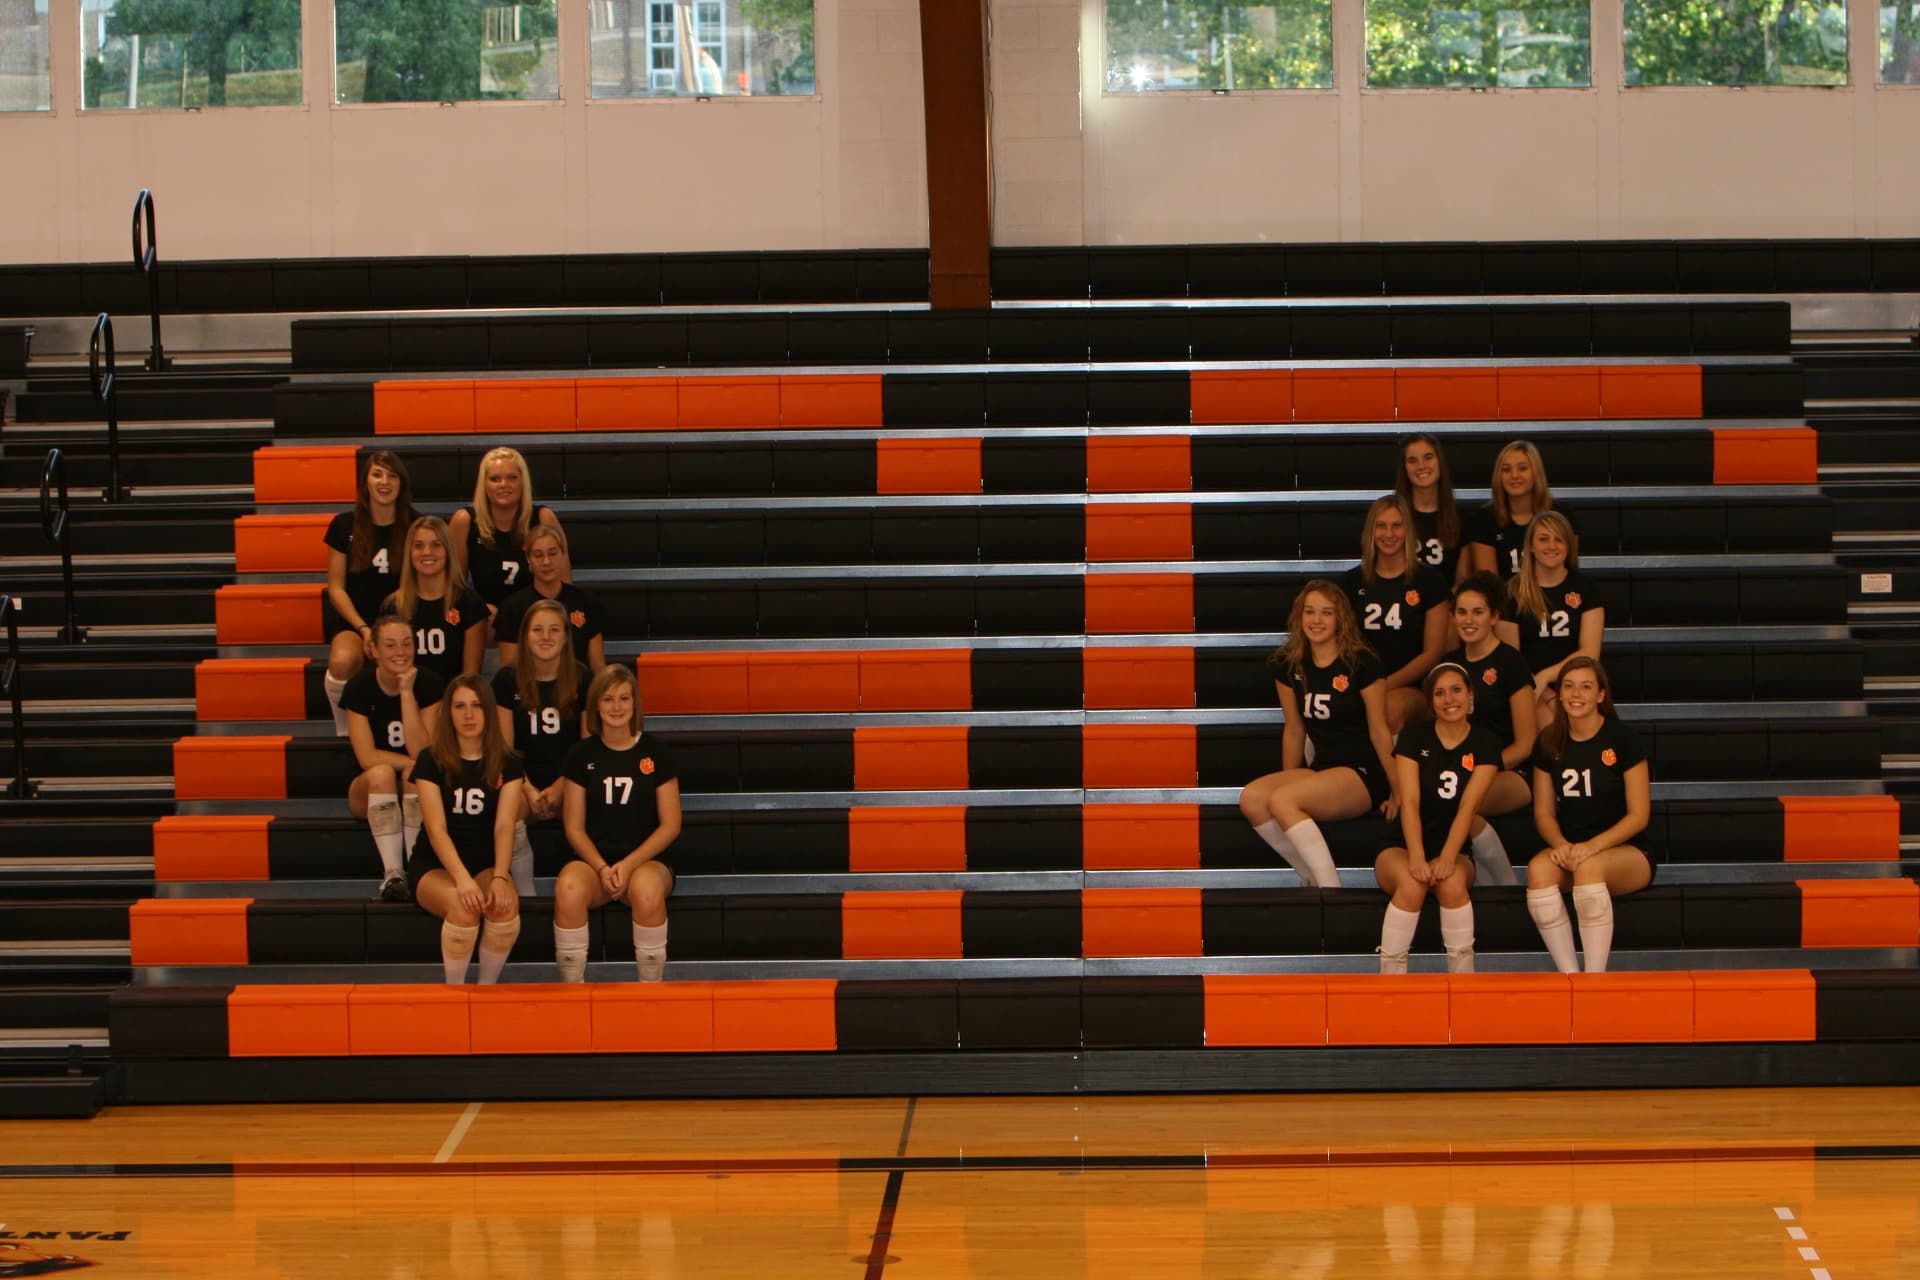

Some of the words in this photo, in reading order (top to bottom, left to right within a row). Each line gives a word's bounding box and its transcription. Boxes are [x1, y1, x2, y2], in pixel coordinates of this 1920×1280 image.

[373, 548, 389, 574] 4
[502, 561, 519, 584] 7
[1509, 548, 1524, 573] 1
[1364, 602, 1403, 630] 24
[1539, 610, 1570, 638] 12
[416, 628, 445, 655] 10
[1303, 692, 1331, 721] 15
[387, 721, 404, 747] 8
[527, 707, 561, 735] 19
[602, 776, 634, 805] 17
[1437, 770, 1459, 800] 3
[1561, 768, 1592, 797] 21
[452, 787, 485, 815] 16
